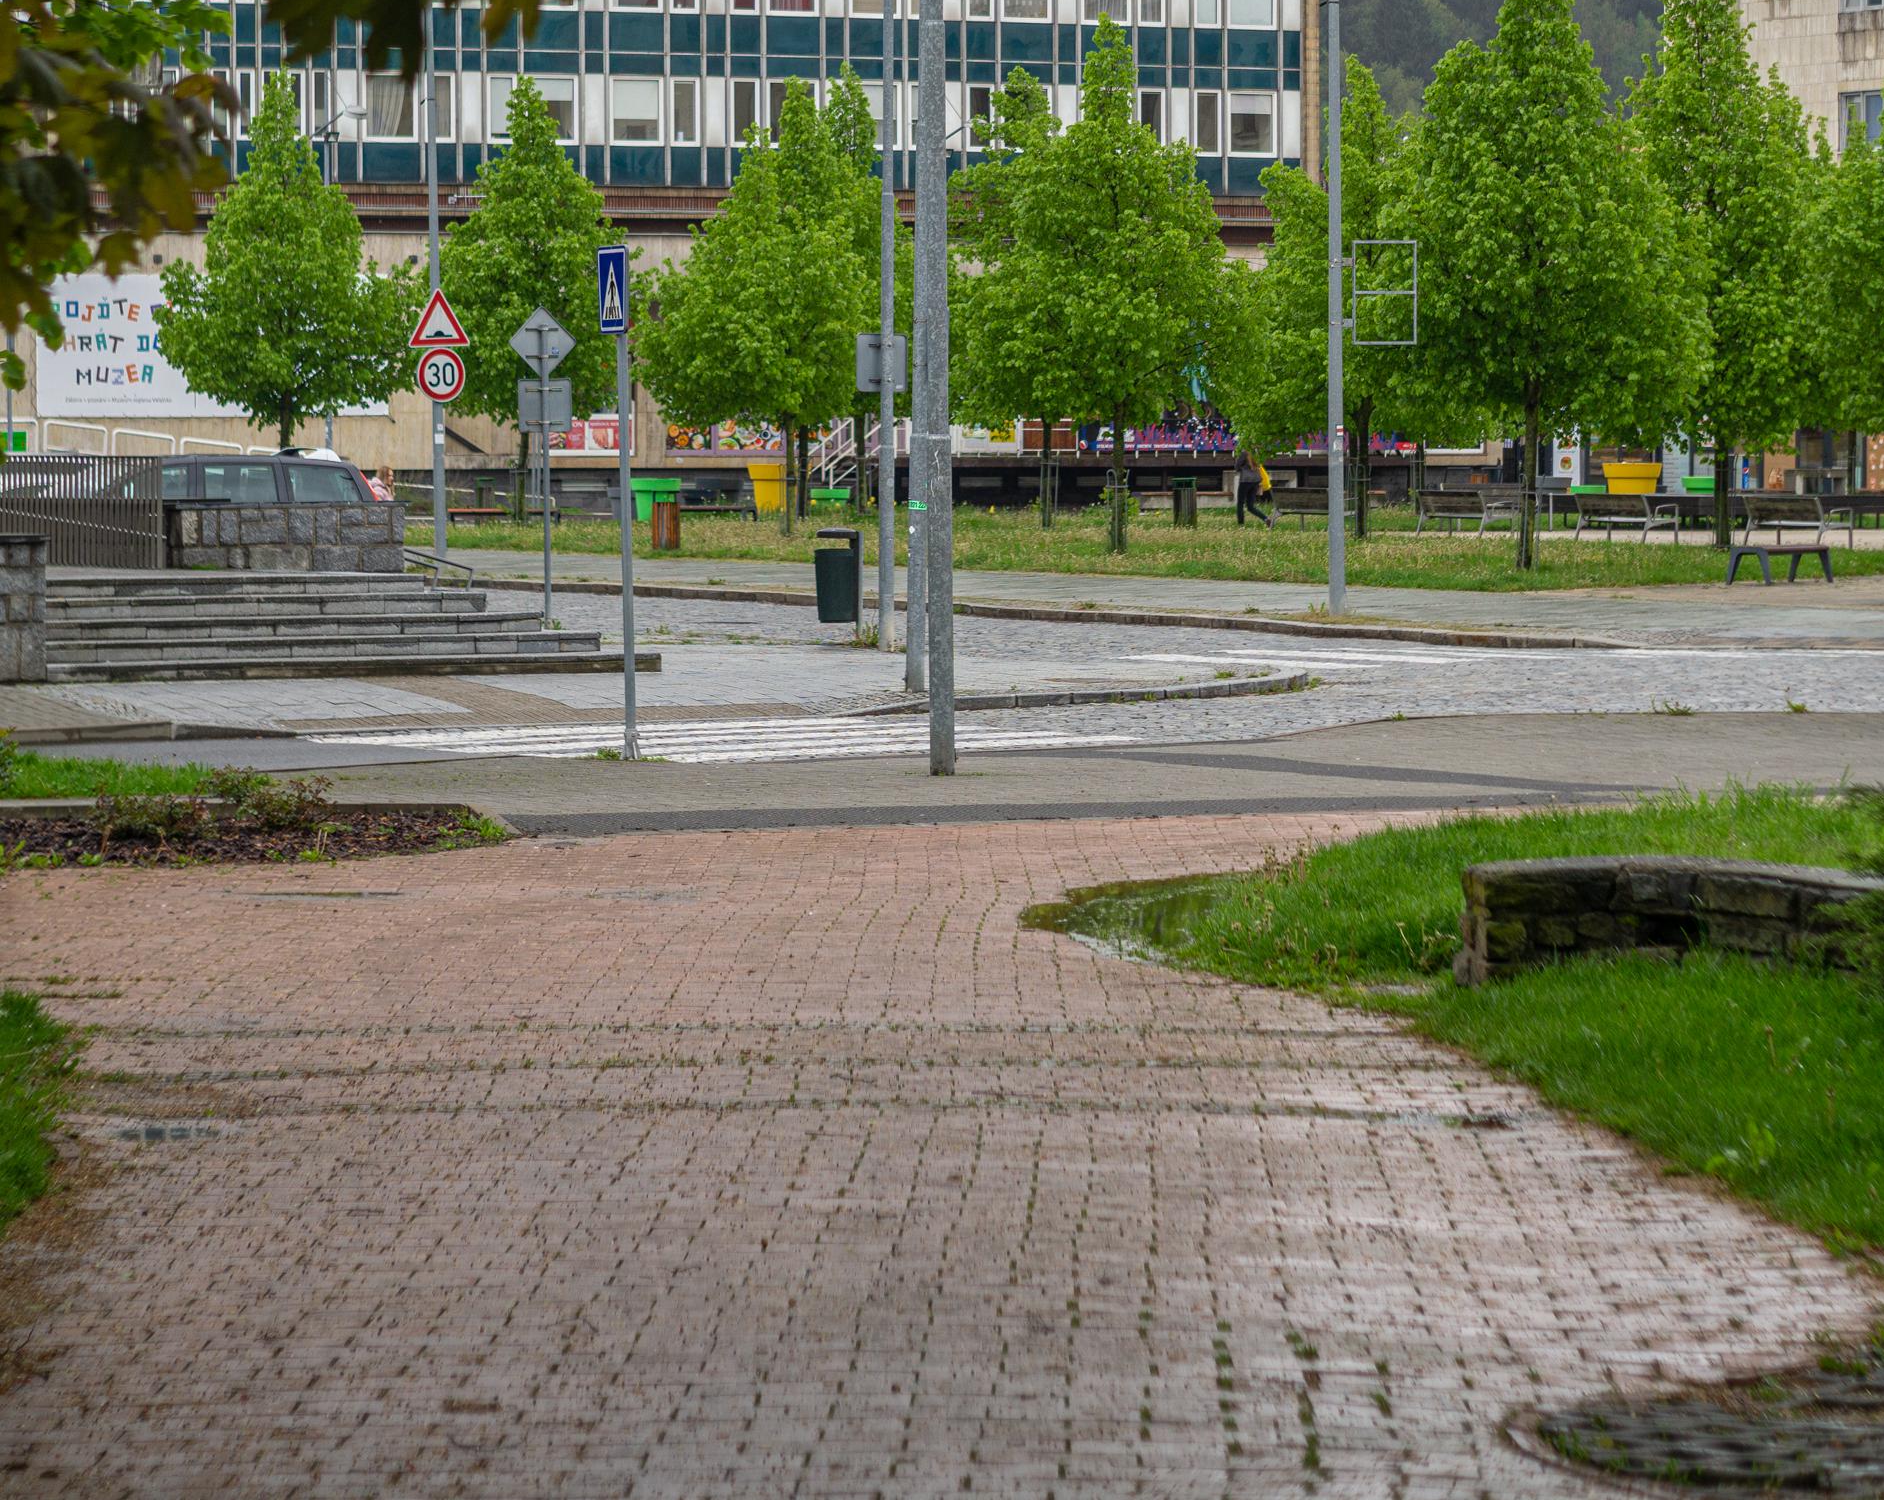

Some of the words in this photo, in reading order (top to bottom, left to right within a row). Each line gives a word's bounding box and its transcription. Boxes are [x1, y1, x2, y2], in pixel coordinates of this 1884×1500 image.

[63, 328, 124, 353] HRÁT
[76, 363, 154, 386] MUZEA
[428, 362, 455, 388] 30
